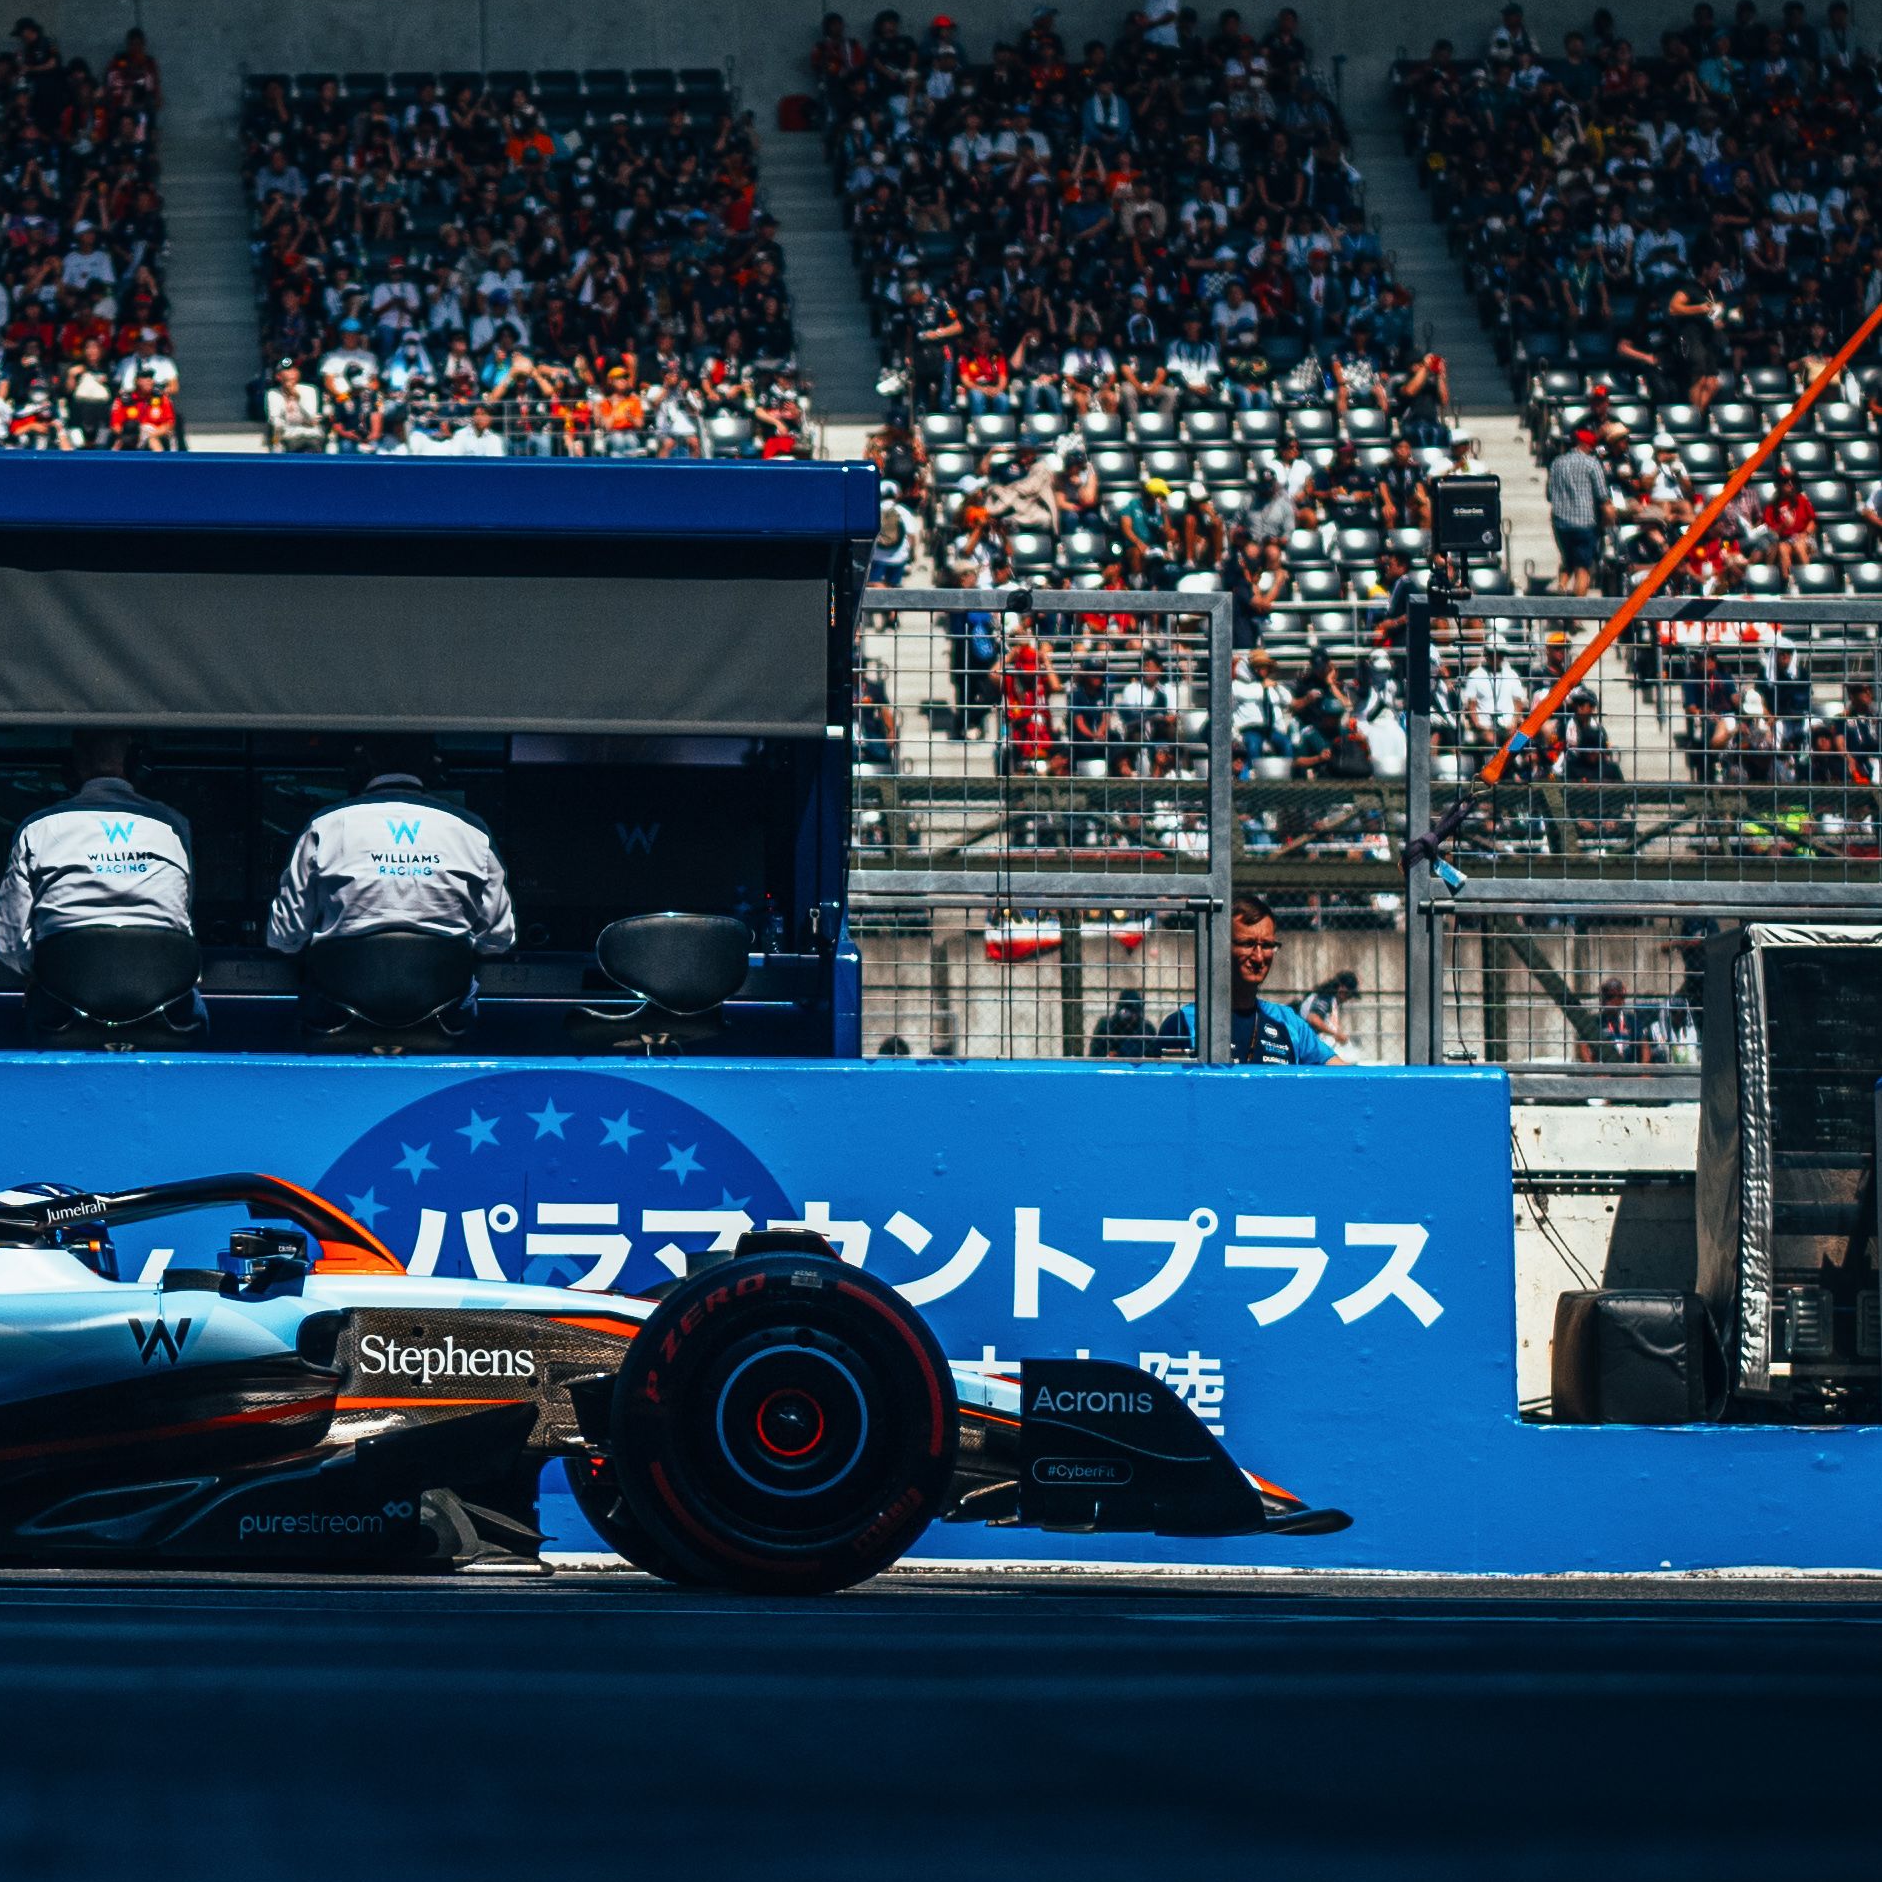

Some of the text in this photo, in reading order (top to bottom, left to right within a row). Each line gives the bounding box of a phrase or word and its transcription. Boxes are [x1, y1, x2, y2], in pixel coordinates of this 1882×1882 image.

[96, 863, 148, 874] RACING
[371, 853, 441, 864] WILLIAMS
[379, 865, 434, 876] RACING
[46, 1199, 107, 1224] Jumeirah
[360, 1335, 535, 1384] Stephens
[1032, 1386, 1153, 1413] Acronis
[1048, 1464, 1115, 1479] #CyberFit
[239, 1514, 382, 1541] purestream
